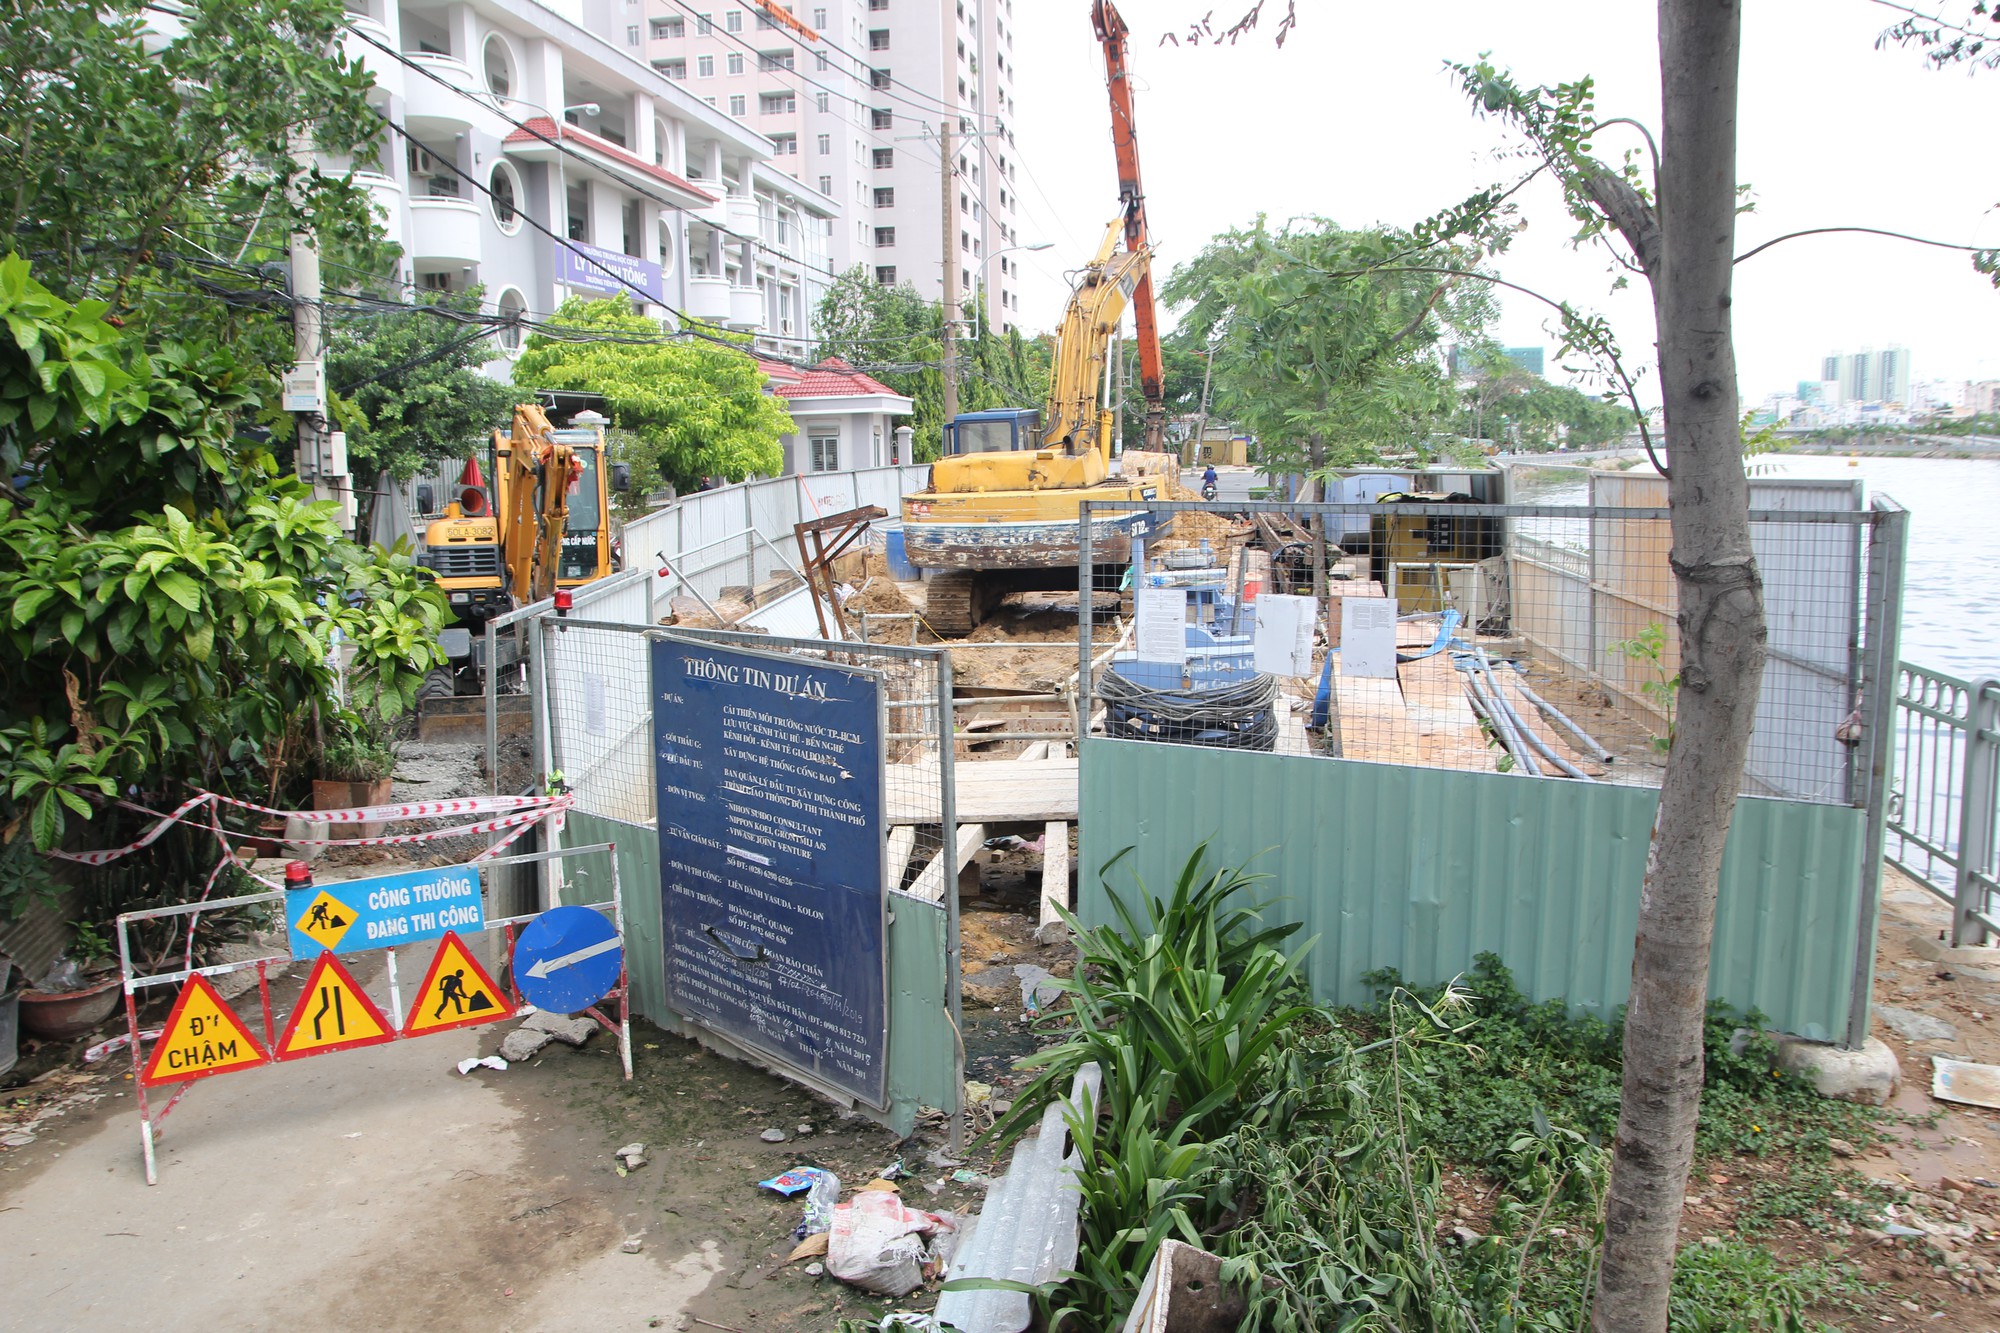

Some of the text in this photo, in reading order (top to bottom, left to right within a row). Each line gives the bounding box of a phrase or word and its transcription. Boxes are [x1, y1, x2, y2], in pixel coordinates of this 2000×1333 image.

[622, 266, 647, 286] TÔNG
[684, 657, 827, 700] THÔNG TIN DỰ ÁN
[723, 729, 742, 741] KÊNH
[760, 738, 780, 751] KÊNH
[735, 707, 757, 720] THIỆN
[757, 712, 772, 723] MÔI
[773, 716, 803, 731] TRƯỜNG
[804, 724, 826, 736] NƯỚC
[839, 731, 860, 743] HCM
[752, 723, 772, 736] KÊNH
[773, 728, 788, 740] TÀU
[804, 735, 820, 747] BẾN
[723, 746, 737, 757] XÂY
[737, 750, 757, 762] DỰNG
[769, 758, 795, 772] THỐNG
[795, 764, 818, 779] CỐNG
[818, 772, 836, 784] BAO
[723, 767, 737, 777] BAN
[796, 787, 812, 799] XÂY
[813, 792, 836, 806] DỰNG
[837, 798, 861, 812] CÔNG
[728, 814, 753, 828] NIPPON
[772, 815, 822, 836] CONSULTANT
[818, 807, 846, 821] THÀNH
[847, 814, 865, 826] PHỐ
[755, 834, 776, 848] JOINT
[777, 841, 811, 859] VENTURE
[368, 877, 471, 911] CÔNG TRƯỜNG
[743, 884, 763, 898] DANH
[763, 892, 792, 909] YASUDA
[796, 904, 823, 920] KOLON
[367, 904, 479, 940] ĐANG THI CÔNG
[727, 903, 752, 918] HOÀNG
[767, 919, 793, 935] QUANG
[794, 1023, 819, 1041] THÁNG
[834, 1040, 852, 1055] NĂM
[838, 1027, 851, 1038] 812
[851, 1032, 867, 1045] 723)
[168, 1040, 238, 1069] CHẬM
[798, 1041, 823, 1059] THÁNG
[835, 1059, 854, 1074] NĂM
